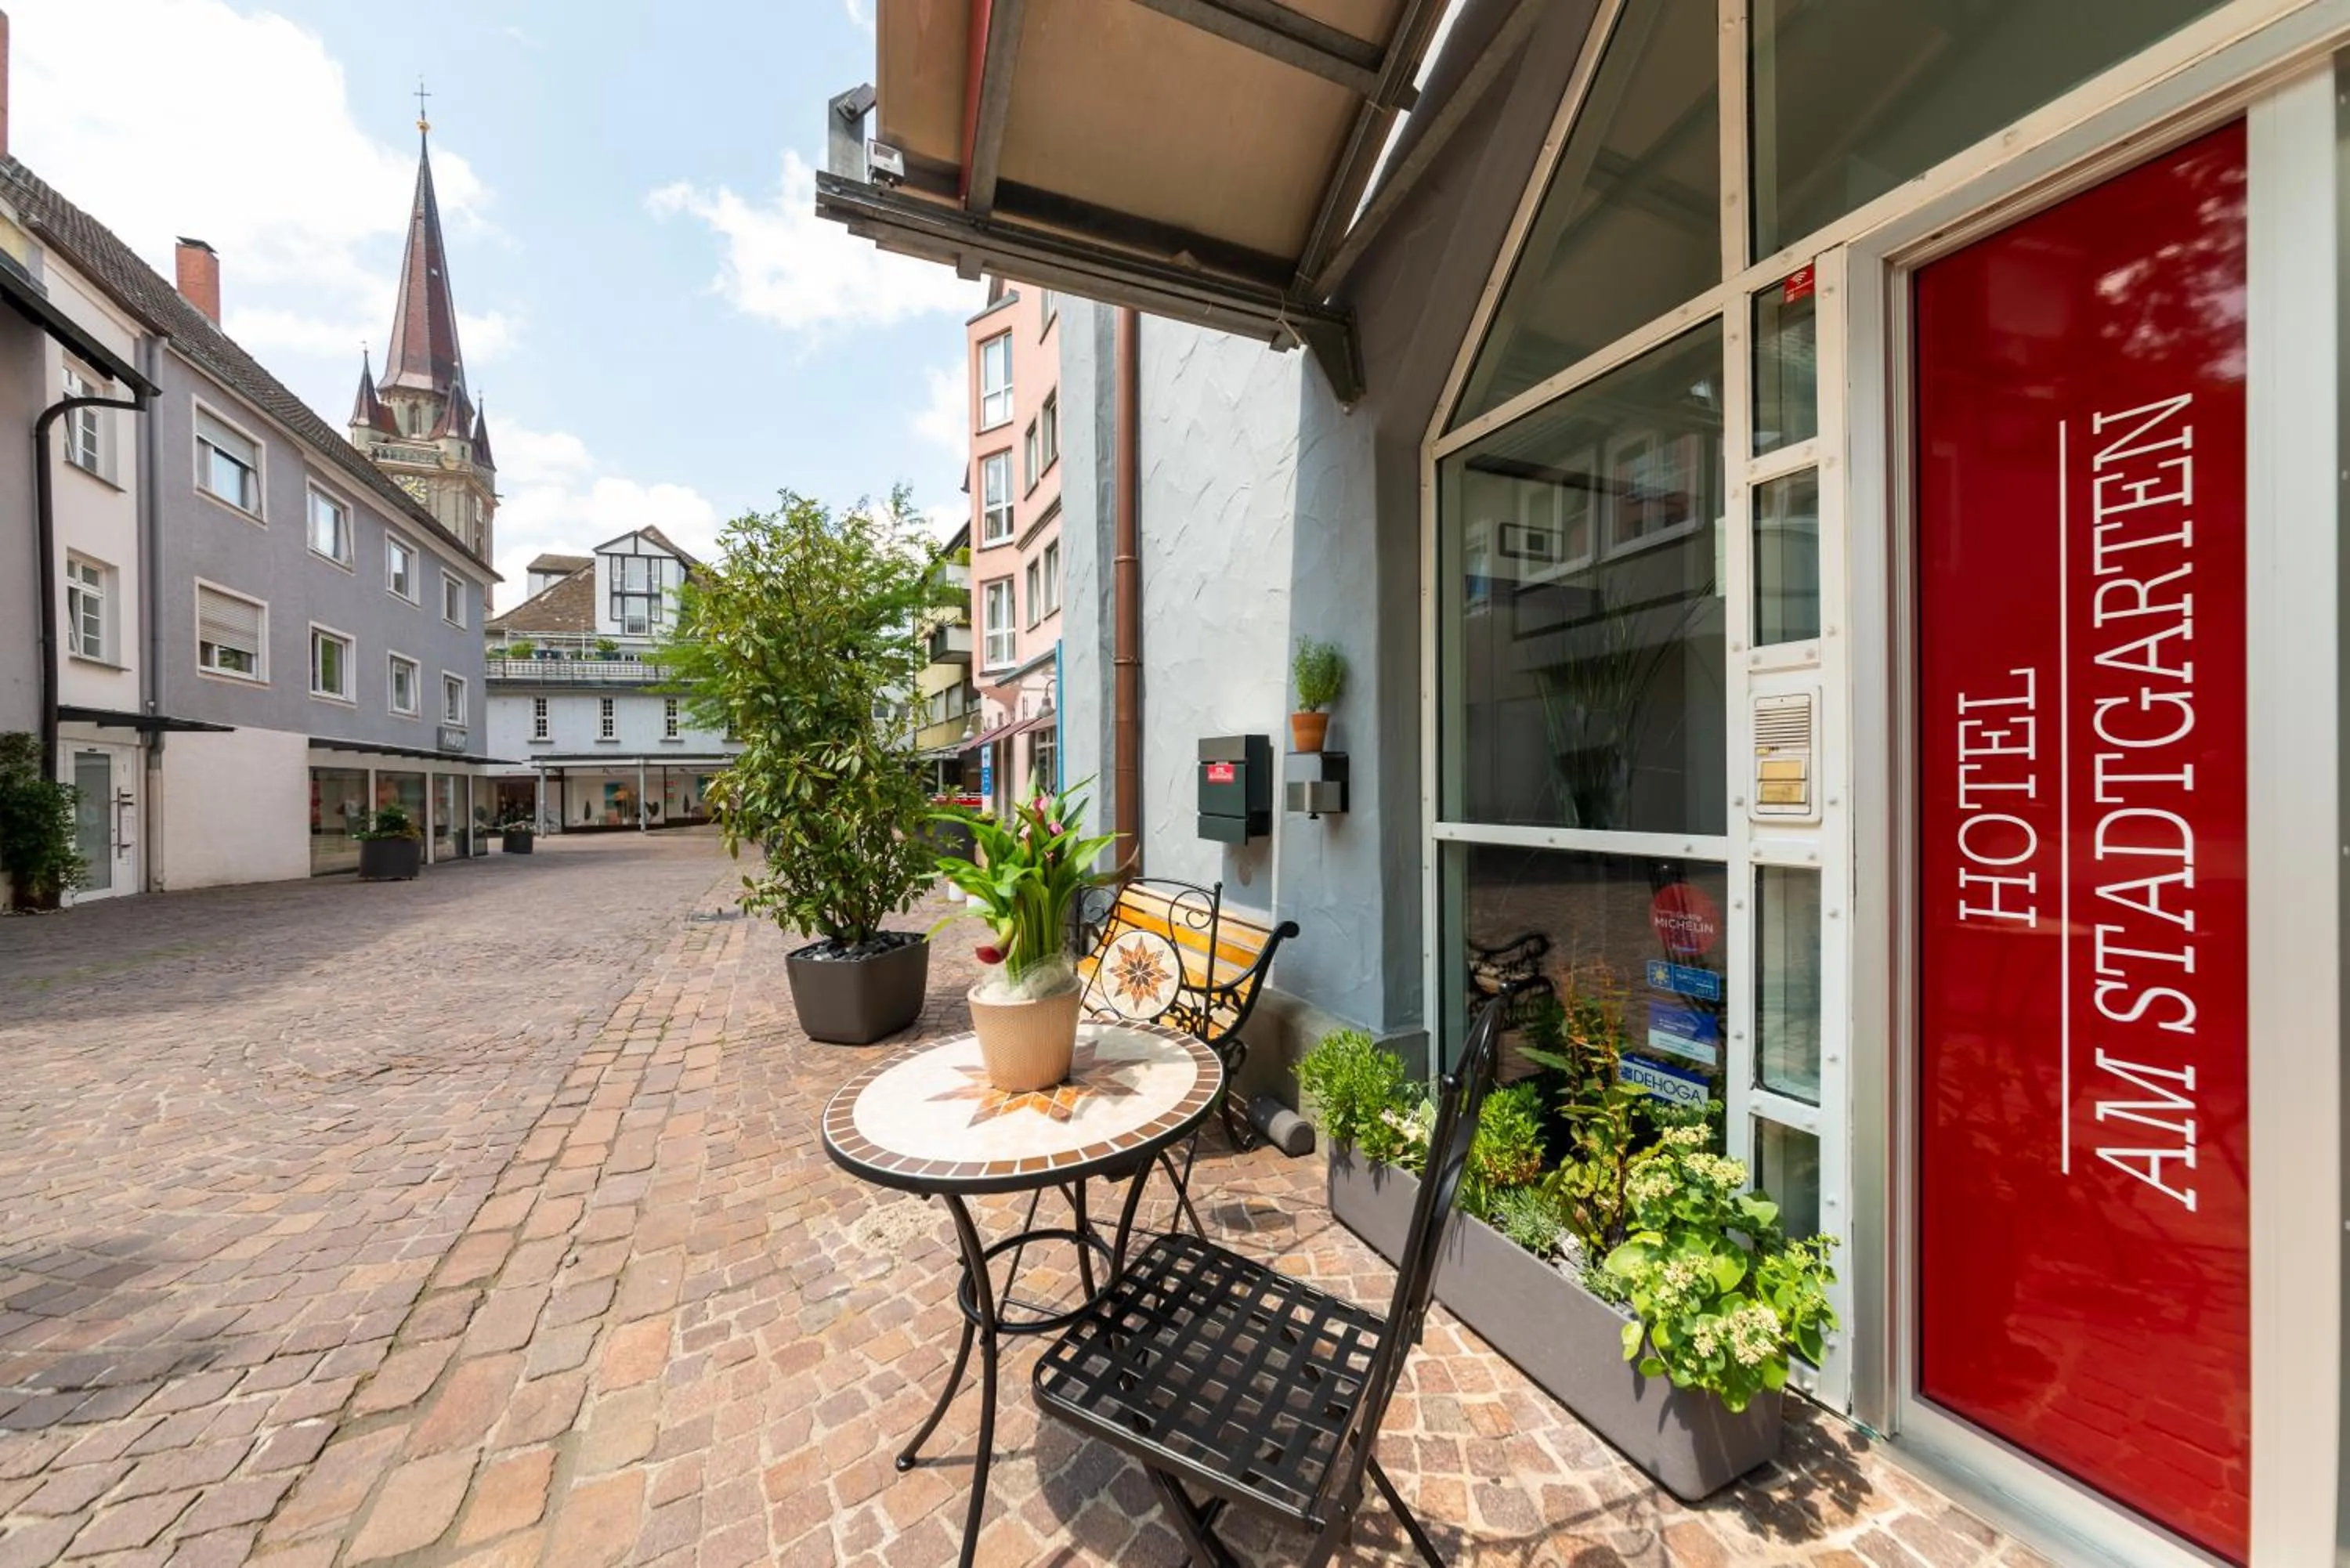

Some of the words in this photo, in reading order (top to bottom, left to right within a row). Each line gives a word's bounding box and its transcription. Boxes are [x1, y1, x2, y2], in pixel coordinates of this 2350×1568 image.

[2092, 392, 2196, 1034] STADTGARTEN
[1958, 667, 2037, 928] HOTEL
[1654, 917, 1714, 934] MICHELIN
[1633, 1069, 1702, 1105] DEHOGA
[2095, 1047, 2196, 1212] AM
